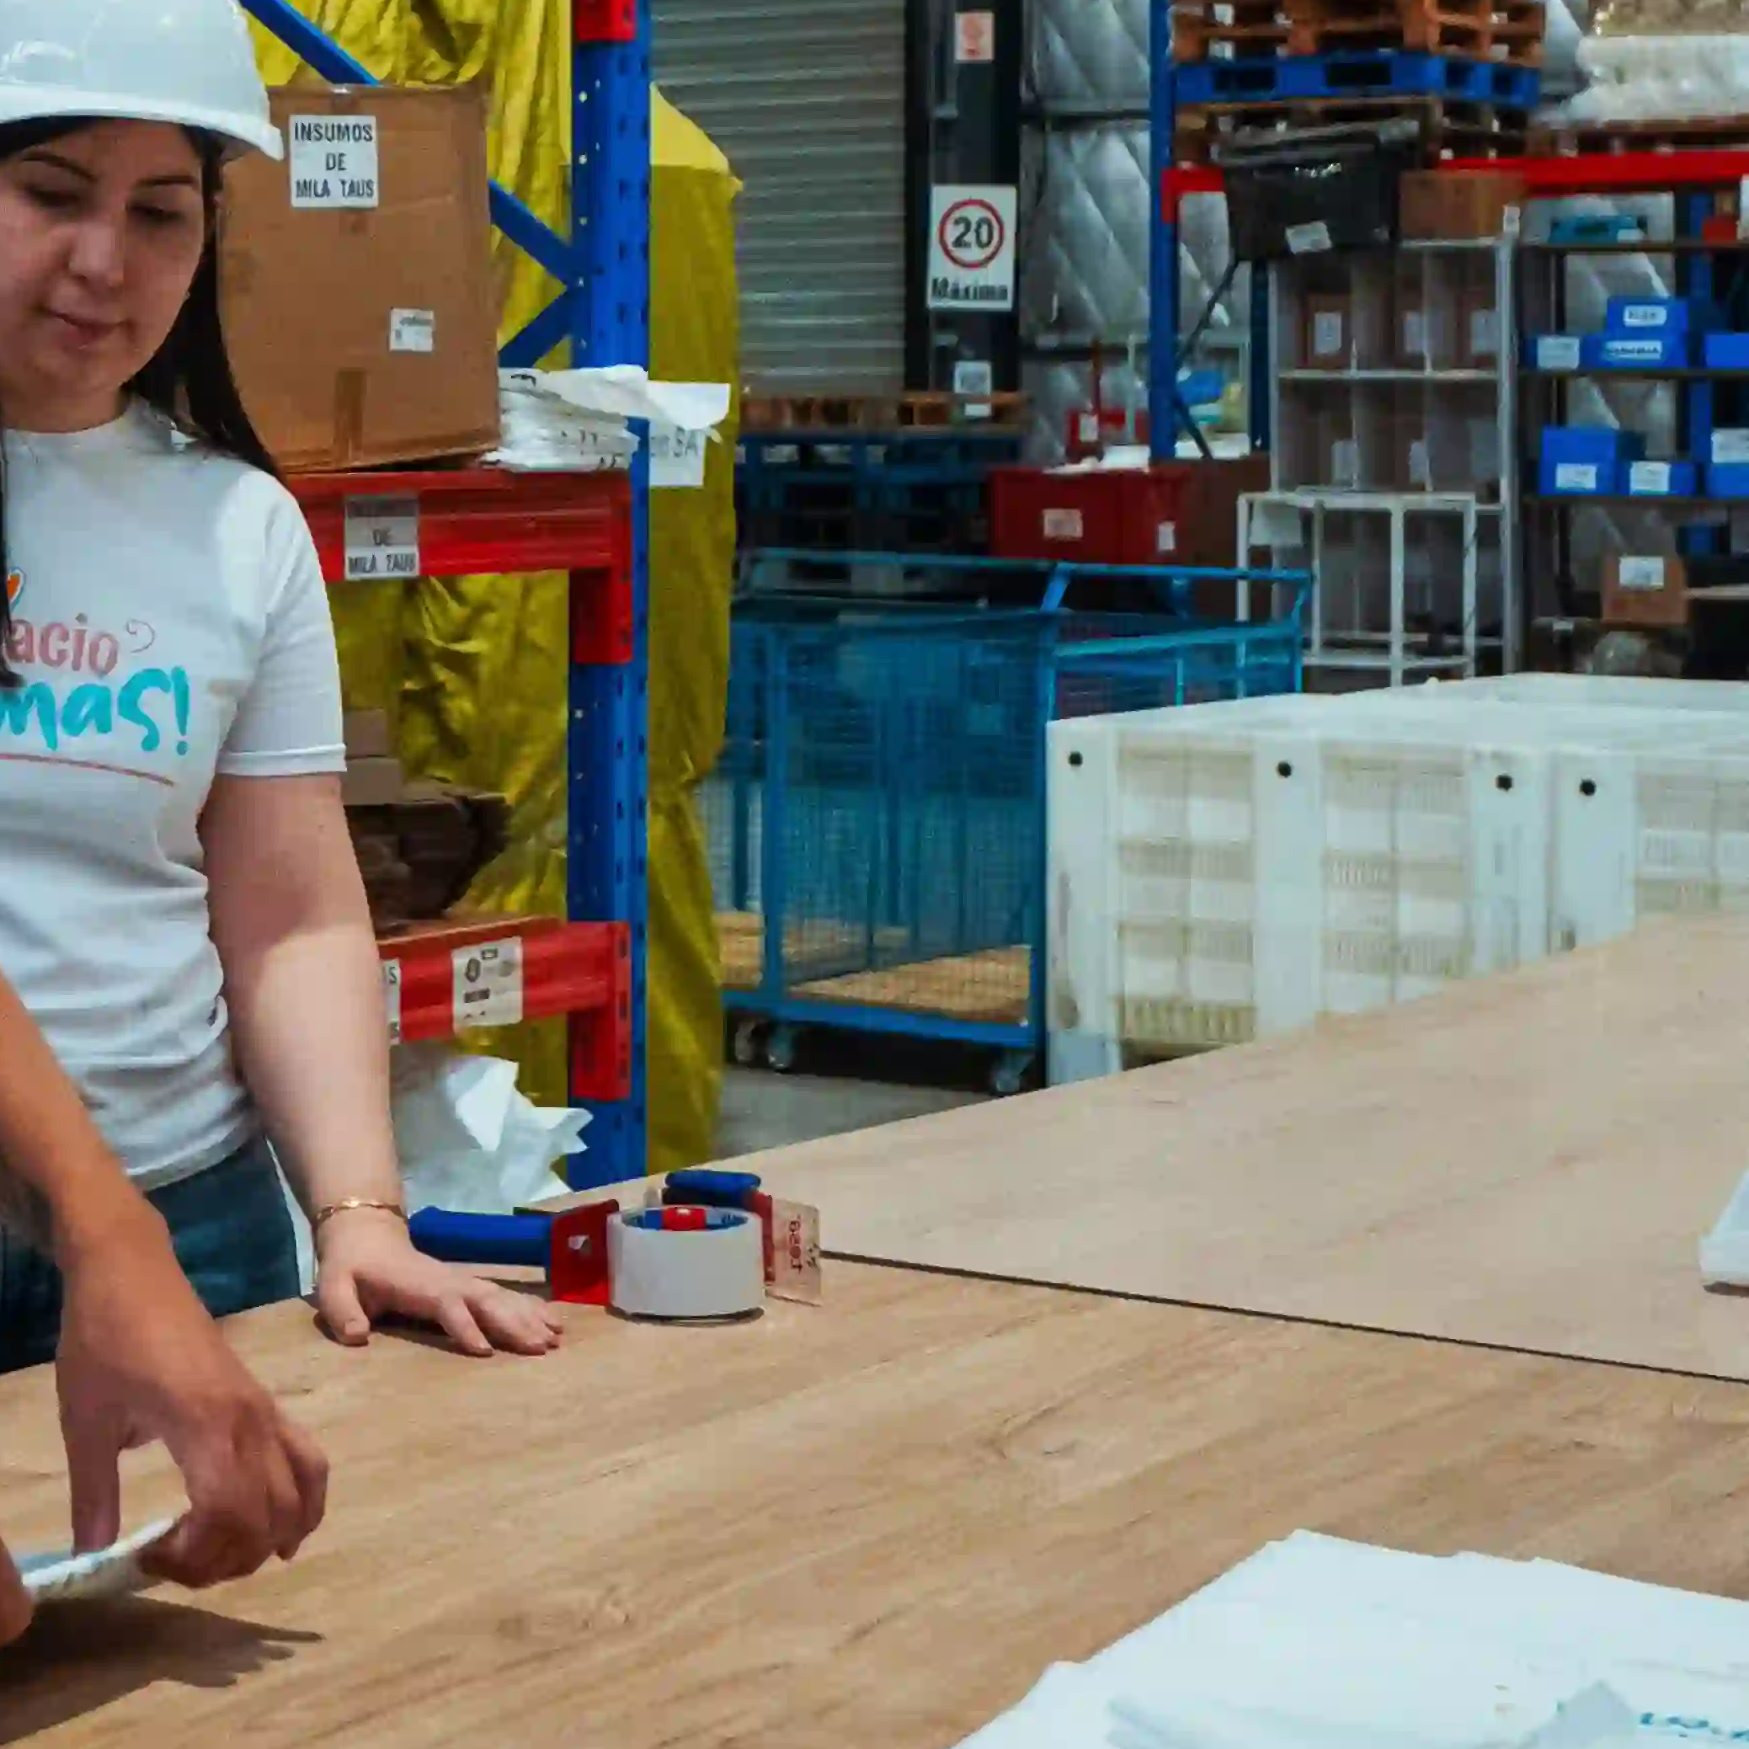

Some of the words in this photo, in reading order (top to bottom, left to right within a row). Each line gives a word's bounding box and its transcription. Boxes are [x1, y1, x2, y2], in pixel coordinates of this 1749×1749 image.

[294, 121, 374, 143] INSUMOS
[325, 152, 348, 172] DE
[295, 178, 332, 199] MILA
[339, 178, 375, 199] TAUS
[951, 215, 994, 250] 20
